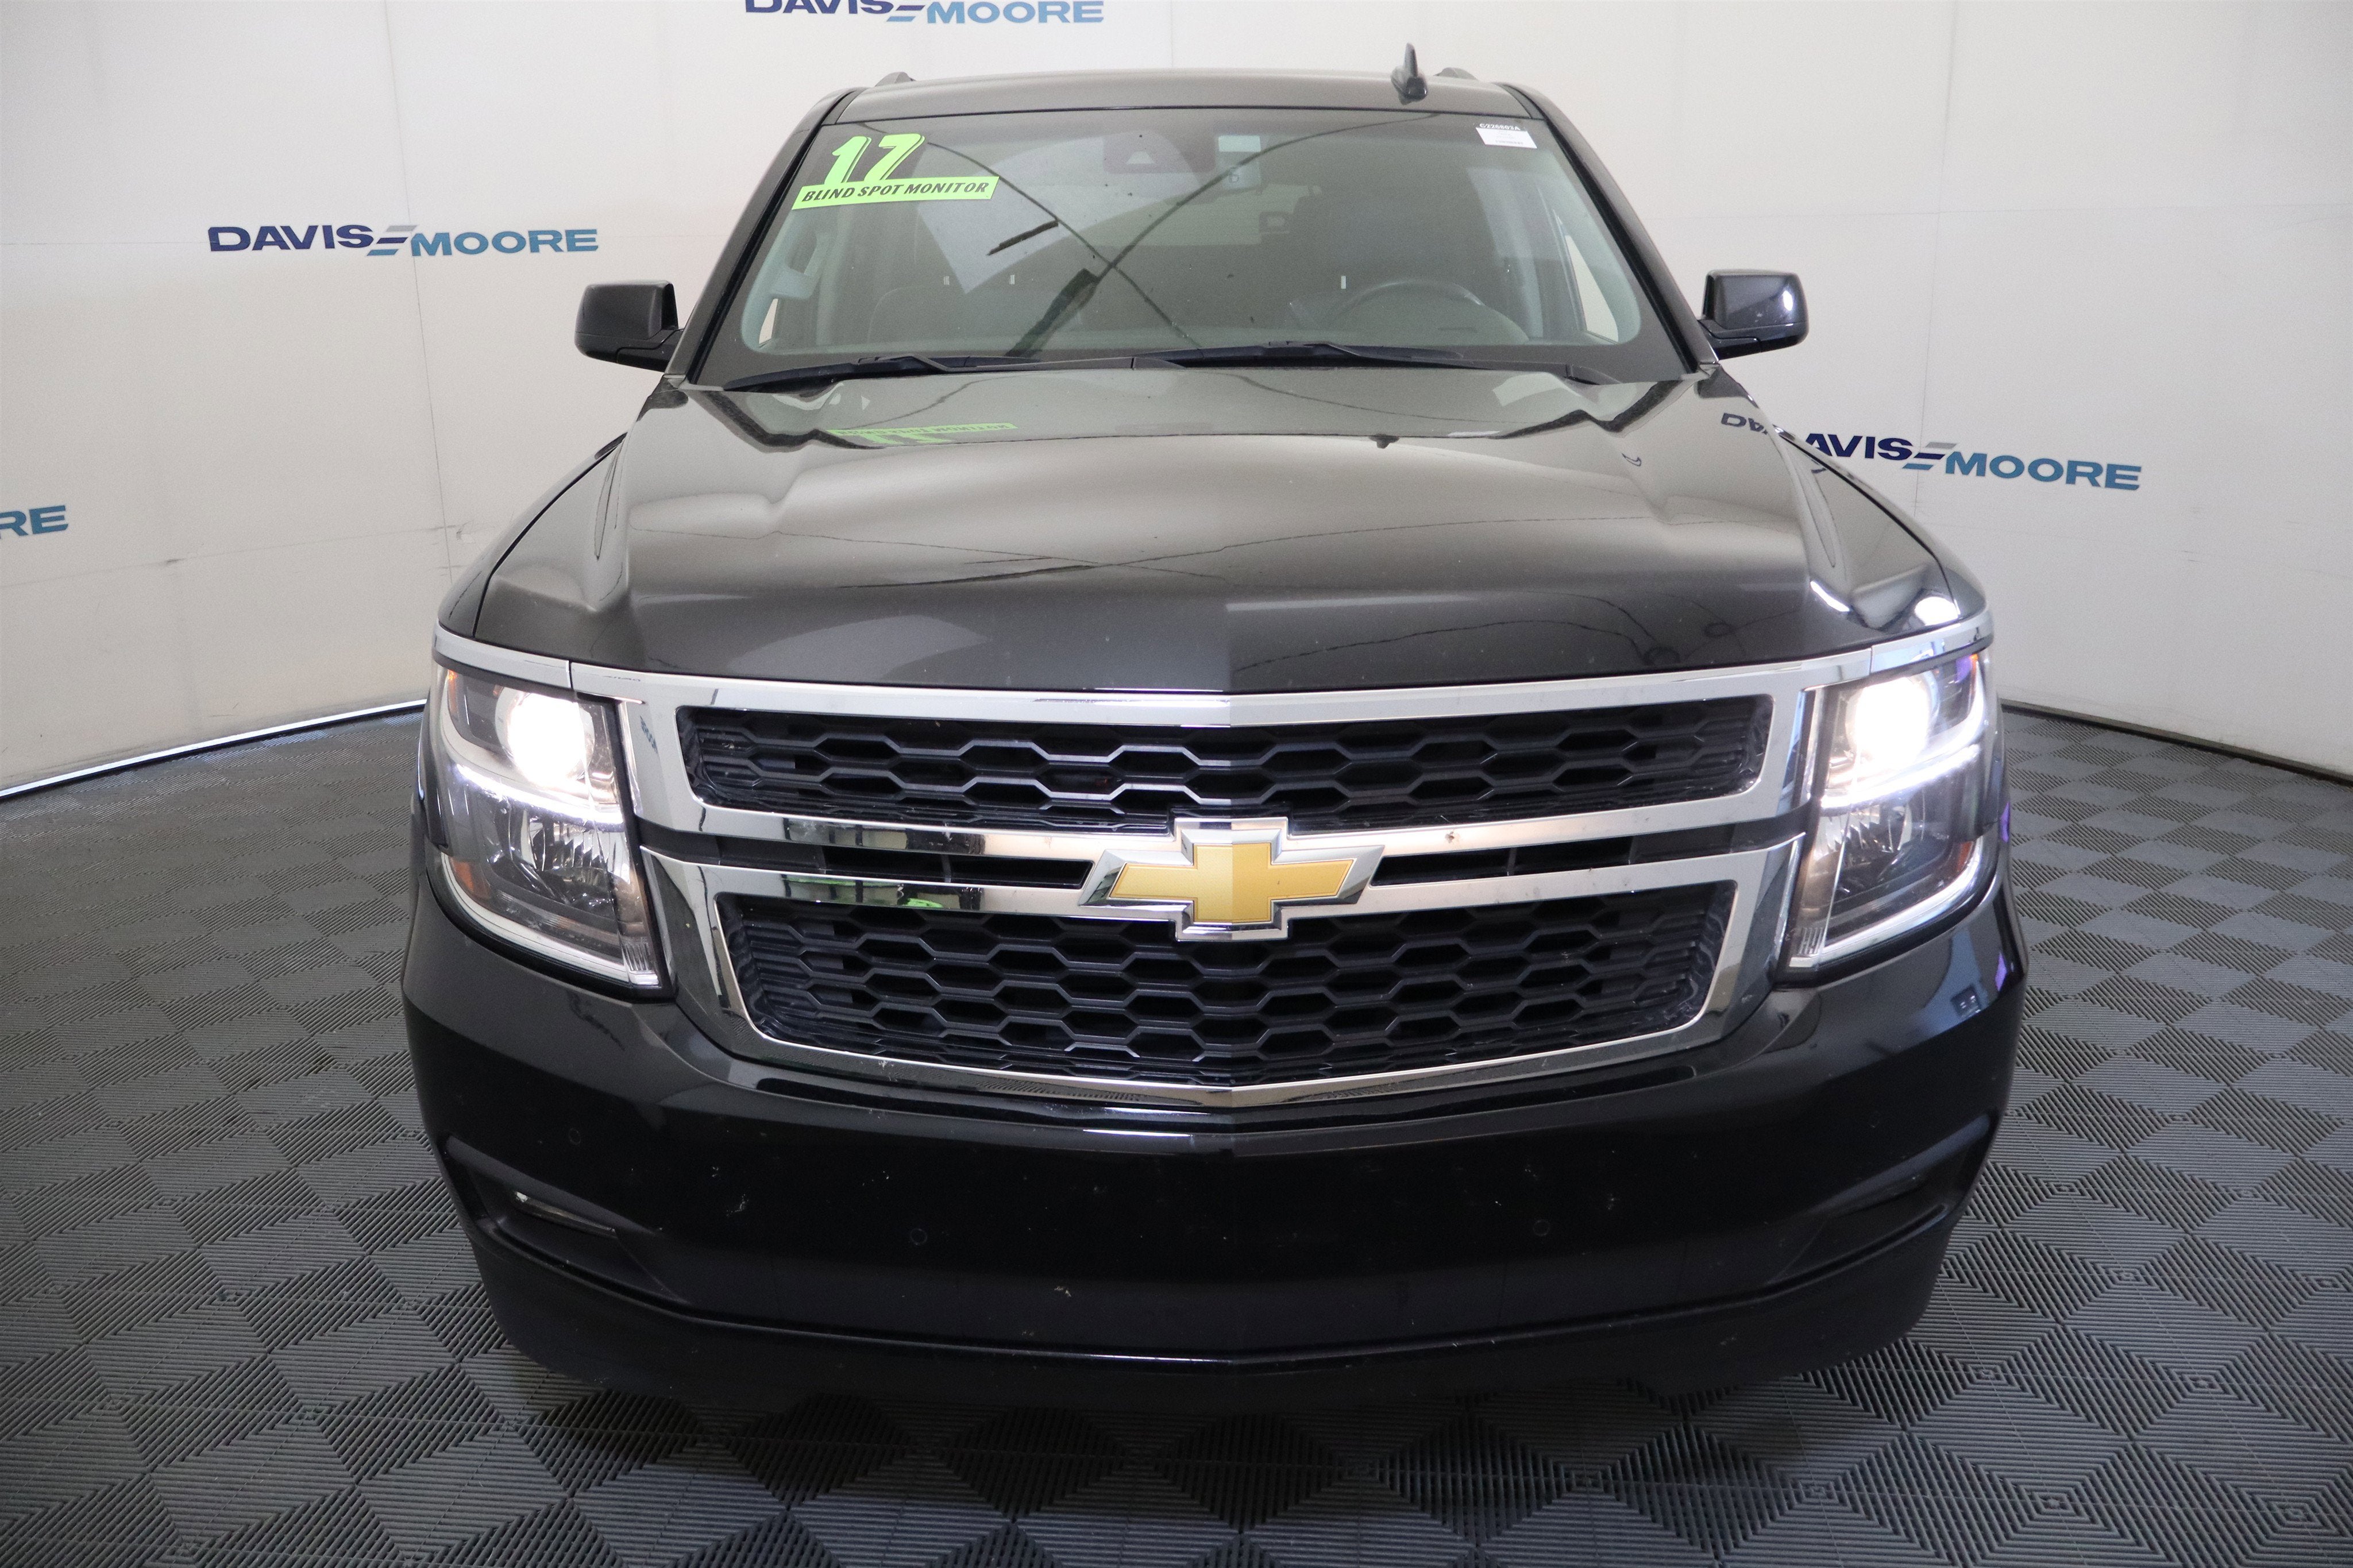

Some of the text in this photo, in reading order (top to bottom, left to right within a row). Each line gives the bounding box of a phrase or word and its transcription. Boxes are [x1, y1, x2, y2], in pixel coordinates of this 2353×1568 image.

[745, 0, 1104, 24] DAVIS MOORE
[824, 133, 925, 185] 17
[801, 182, 989, 202] BLIND SPOT MONITOR
[208, 225, 599, 256] DAVIS MOORE
[1806, 433, 2142, 490] AVIS MOORE
